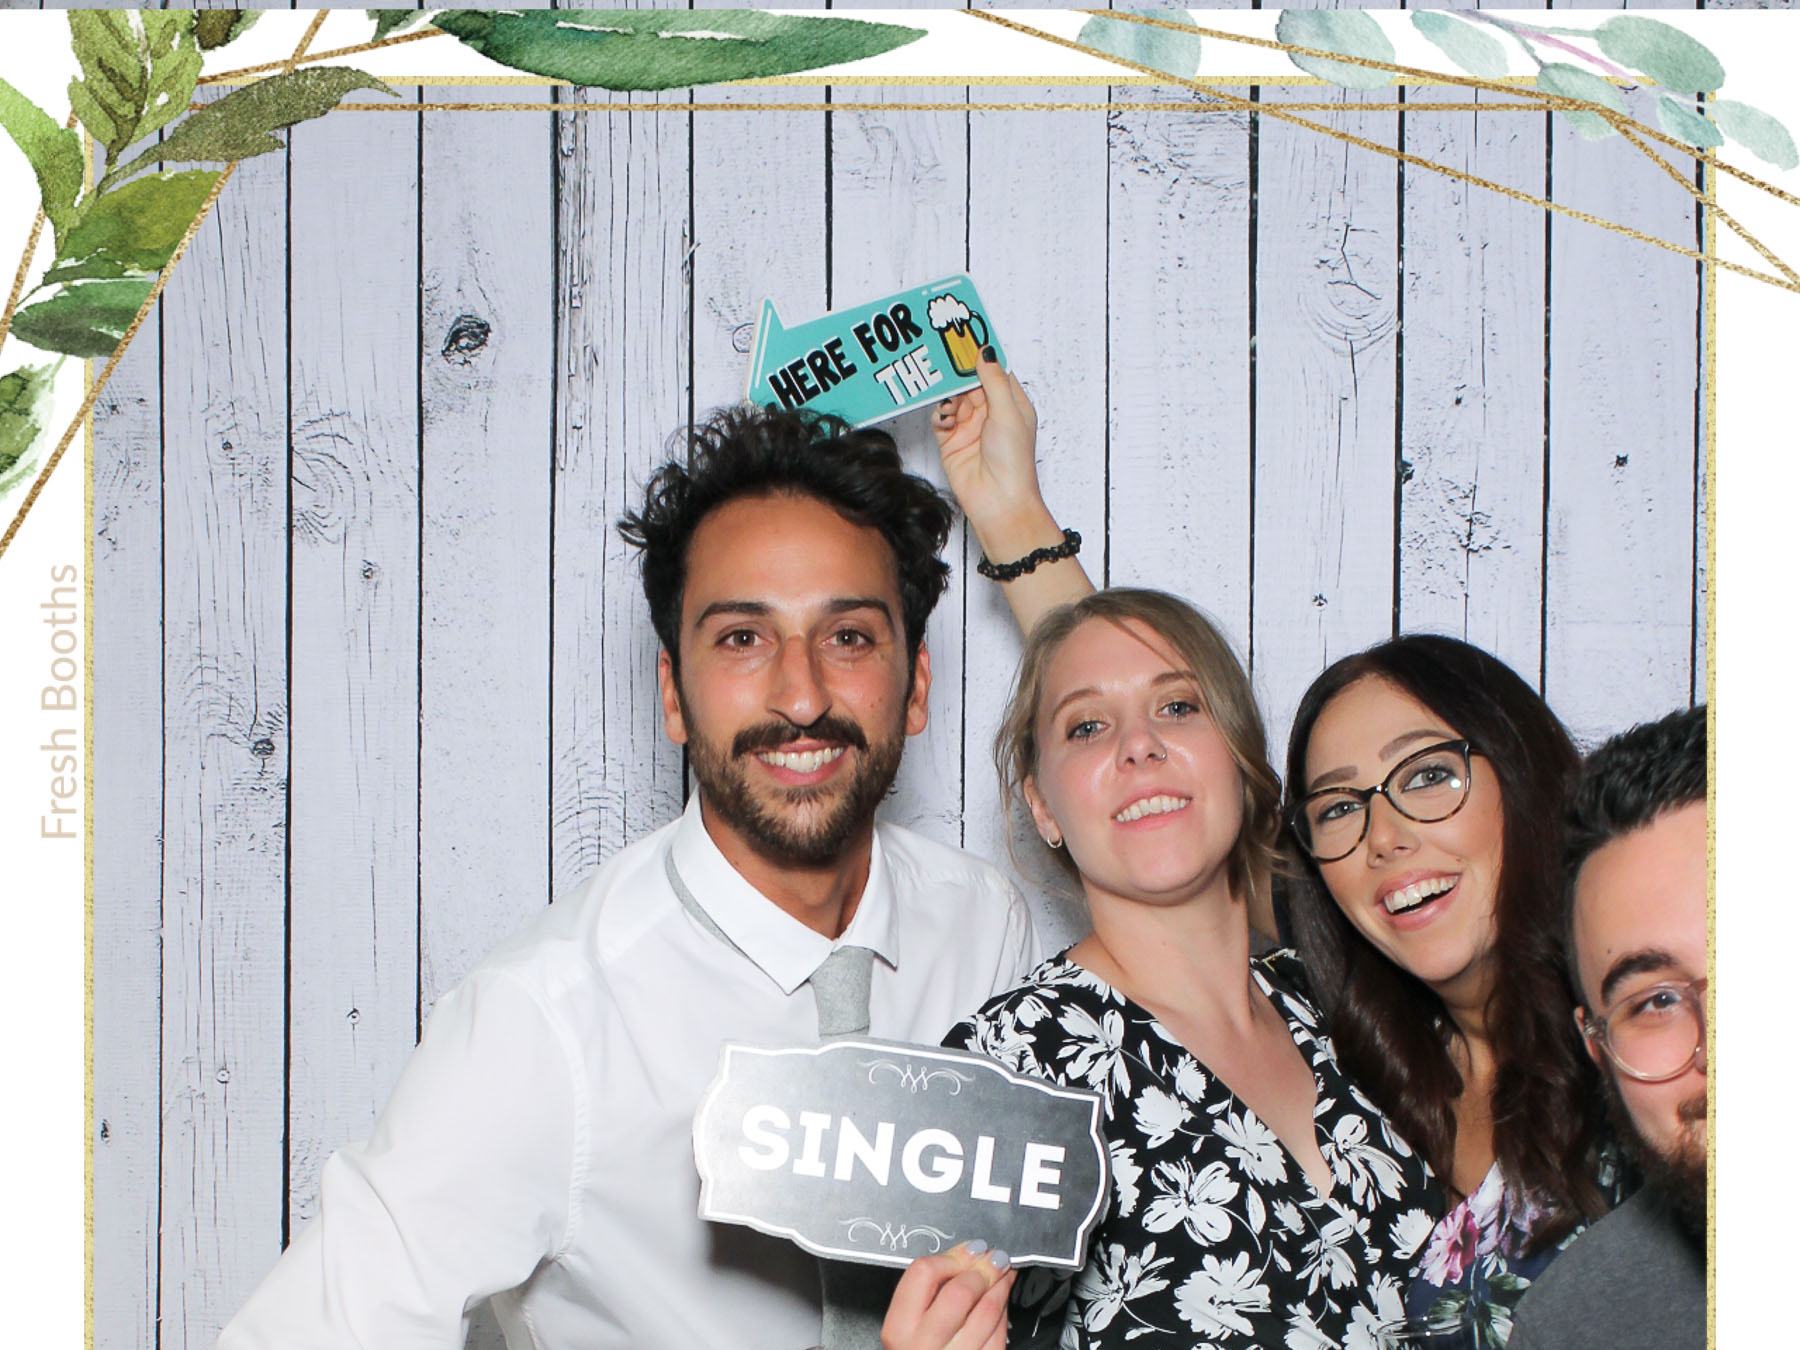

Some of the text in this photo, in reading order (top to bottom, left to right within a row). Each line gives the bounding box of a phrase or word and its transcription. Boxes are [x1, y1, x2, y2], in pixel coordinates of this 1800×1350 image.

[766, 302, 923, 411] HERE FOR
[873, 344, 943, 406] THE
[737, 1104, 1067, 1211] SINGLE
